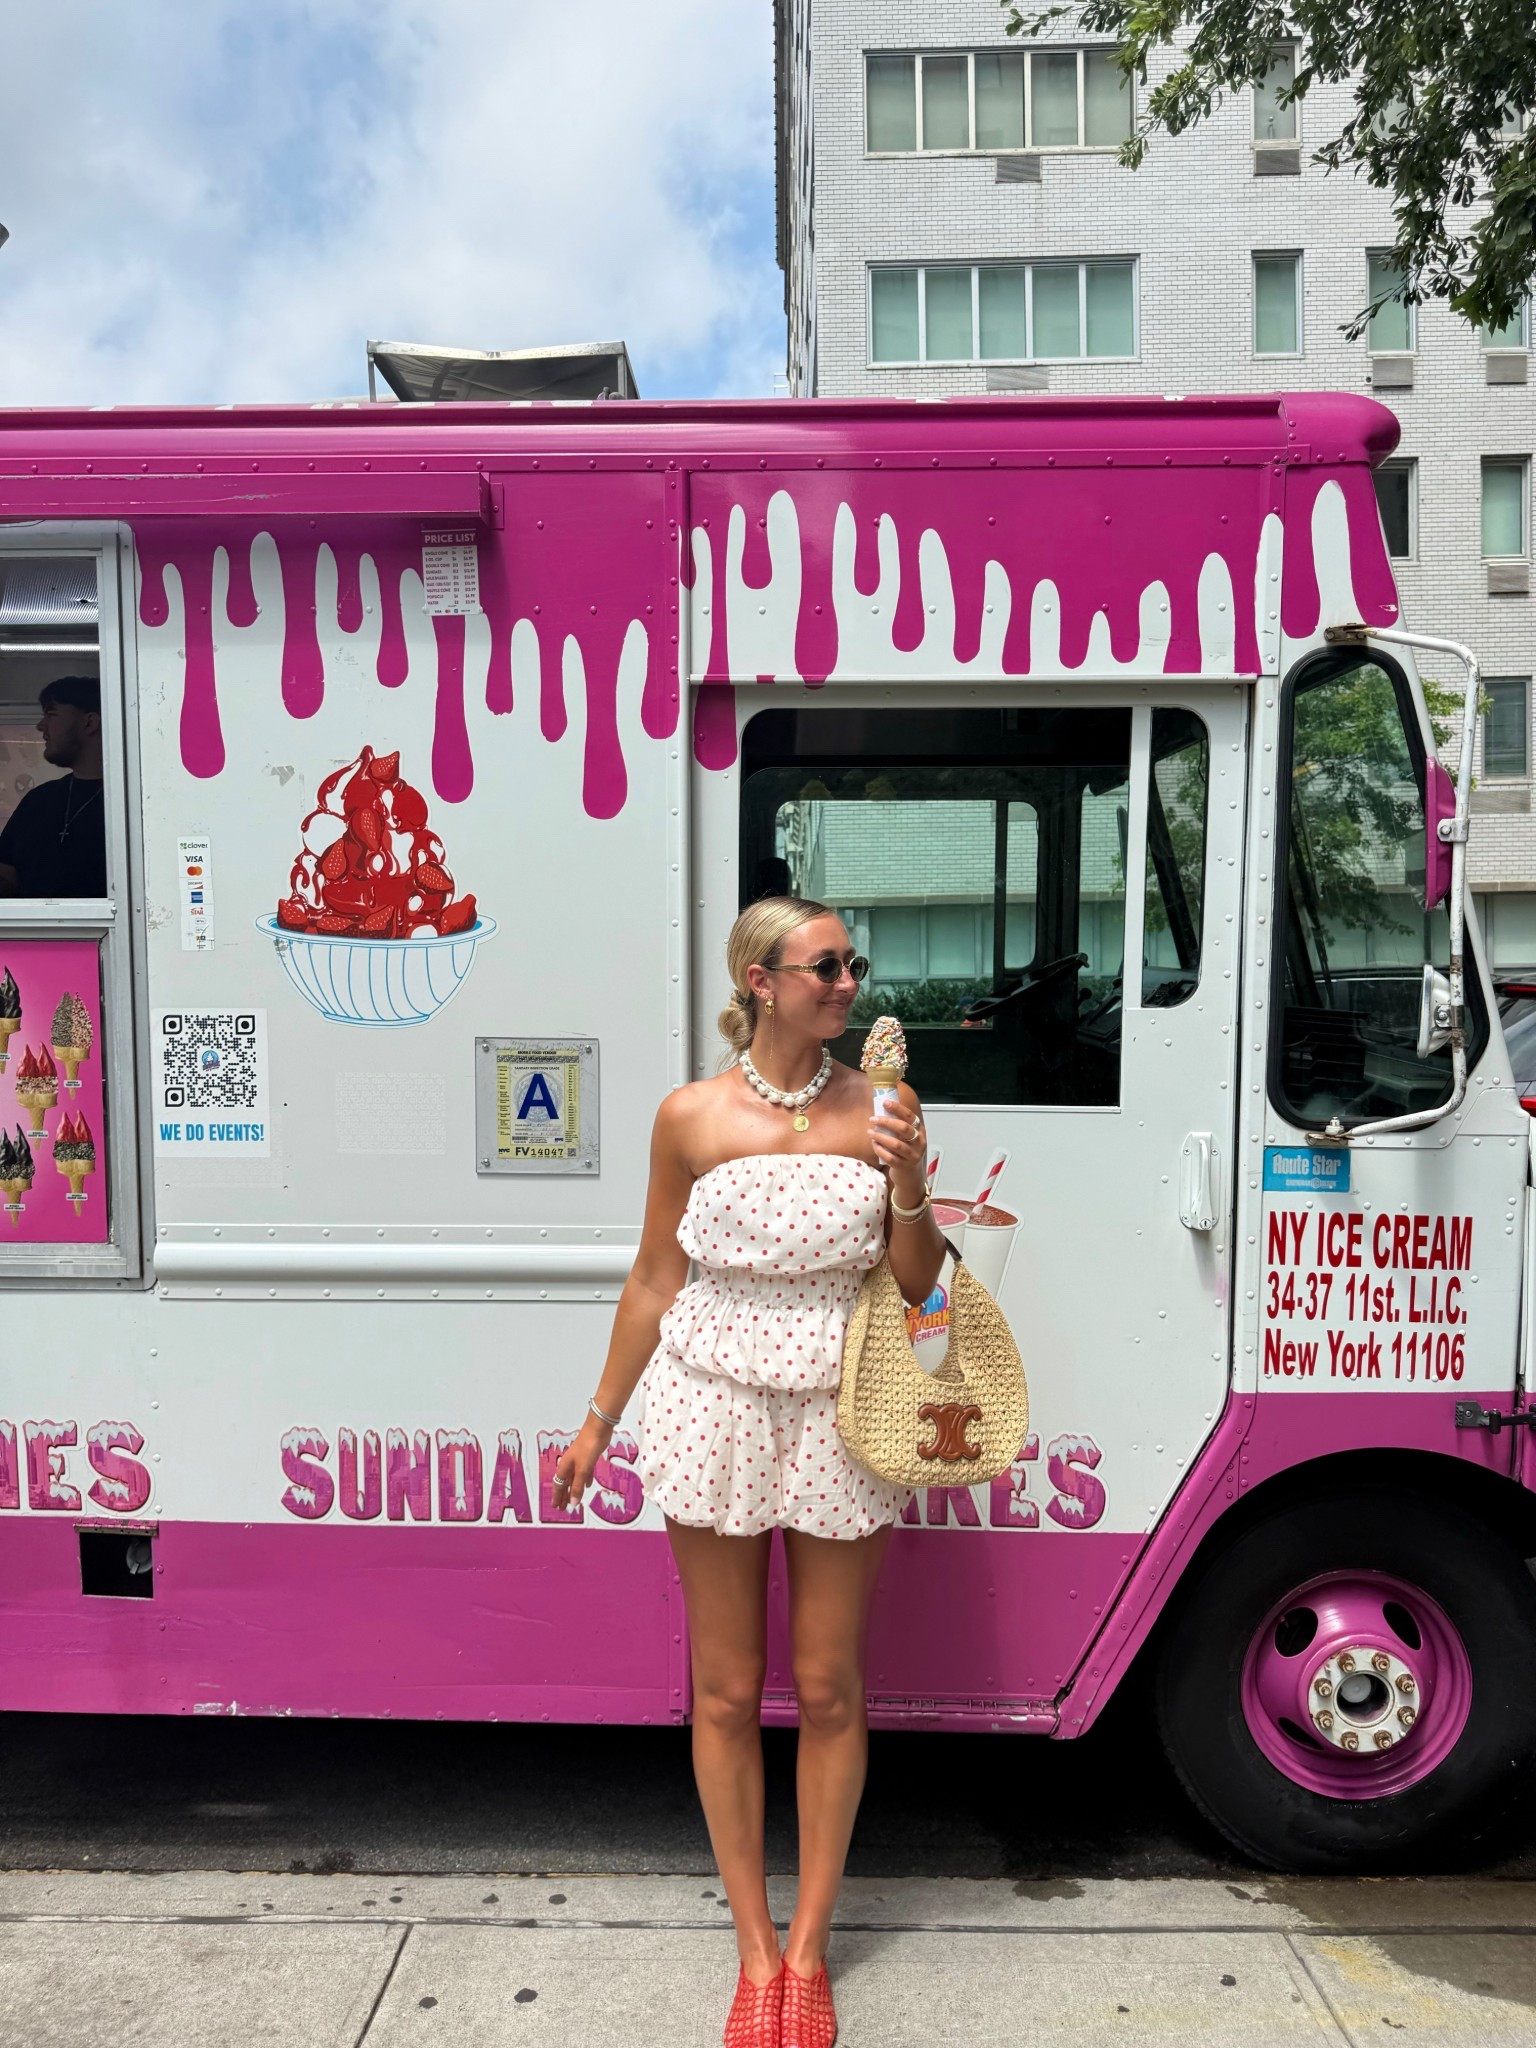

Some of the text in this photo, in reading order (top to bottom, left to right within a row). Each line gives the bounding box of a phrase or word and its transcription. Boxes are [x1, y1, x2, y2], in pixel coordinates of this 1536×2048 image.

[424, 533, 476, 544] PRICE LIST
[184, 855, 204, 863] VISA
[517, 1073, 560, 1120] A
[159, 1123, 265, 1142] WE DO EVENTS!
[1272, 1153, 1342, 1176] Route Star
[1267, 1210, 1473, 1271] NY ICE CREAM
[1266, 1270, 1468, 1325] 34-37 11st. L.I.C.
[916, 1326, 946, 1342] CREAM
[1263, 1327, 1466, 1382] New York 11106
[280, 1426, 645, 1525] SUNDAES
